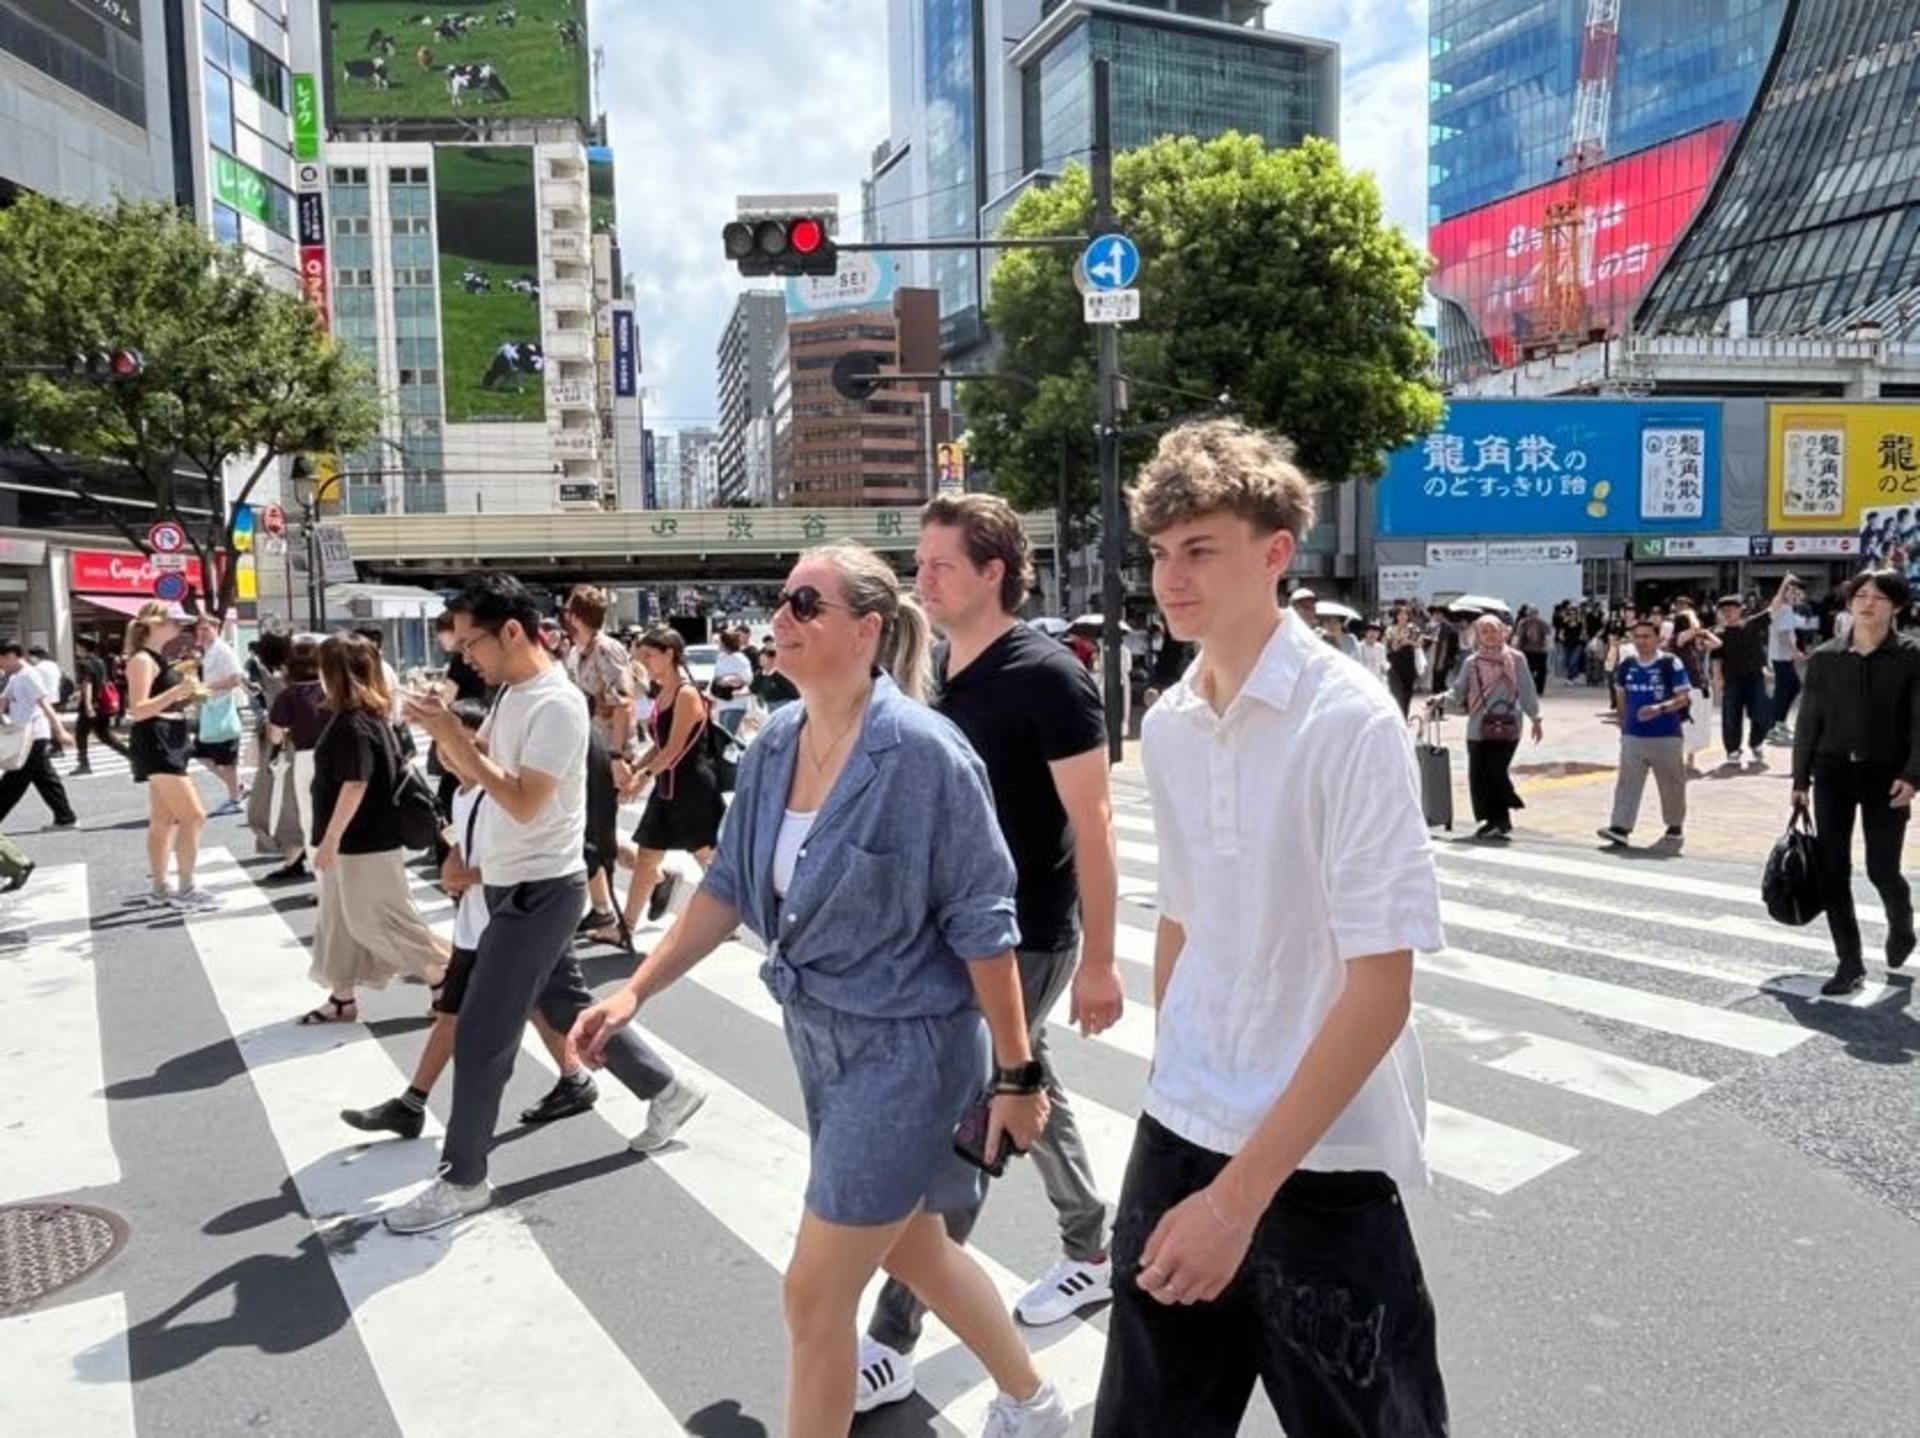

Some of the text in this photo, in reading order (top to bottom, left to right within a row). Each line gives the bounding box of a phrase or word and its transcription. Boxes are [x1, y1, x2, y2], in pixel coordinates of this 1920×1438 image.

[297, 82, 312, 127] レイク
[220, 157, 269, 208] レイク
[1423, 434, 1587, 474] 龍角散の
[1679, 434, 1701, 513] 龍角散の
[1818, 434, 1841, 512] 龍角散の
[1423, 474, 1587, 496] のどすっきり飴
[651, 512, 902, 540] JR 渋谷駅
